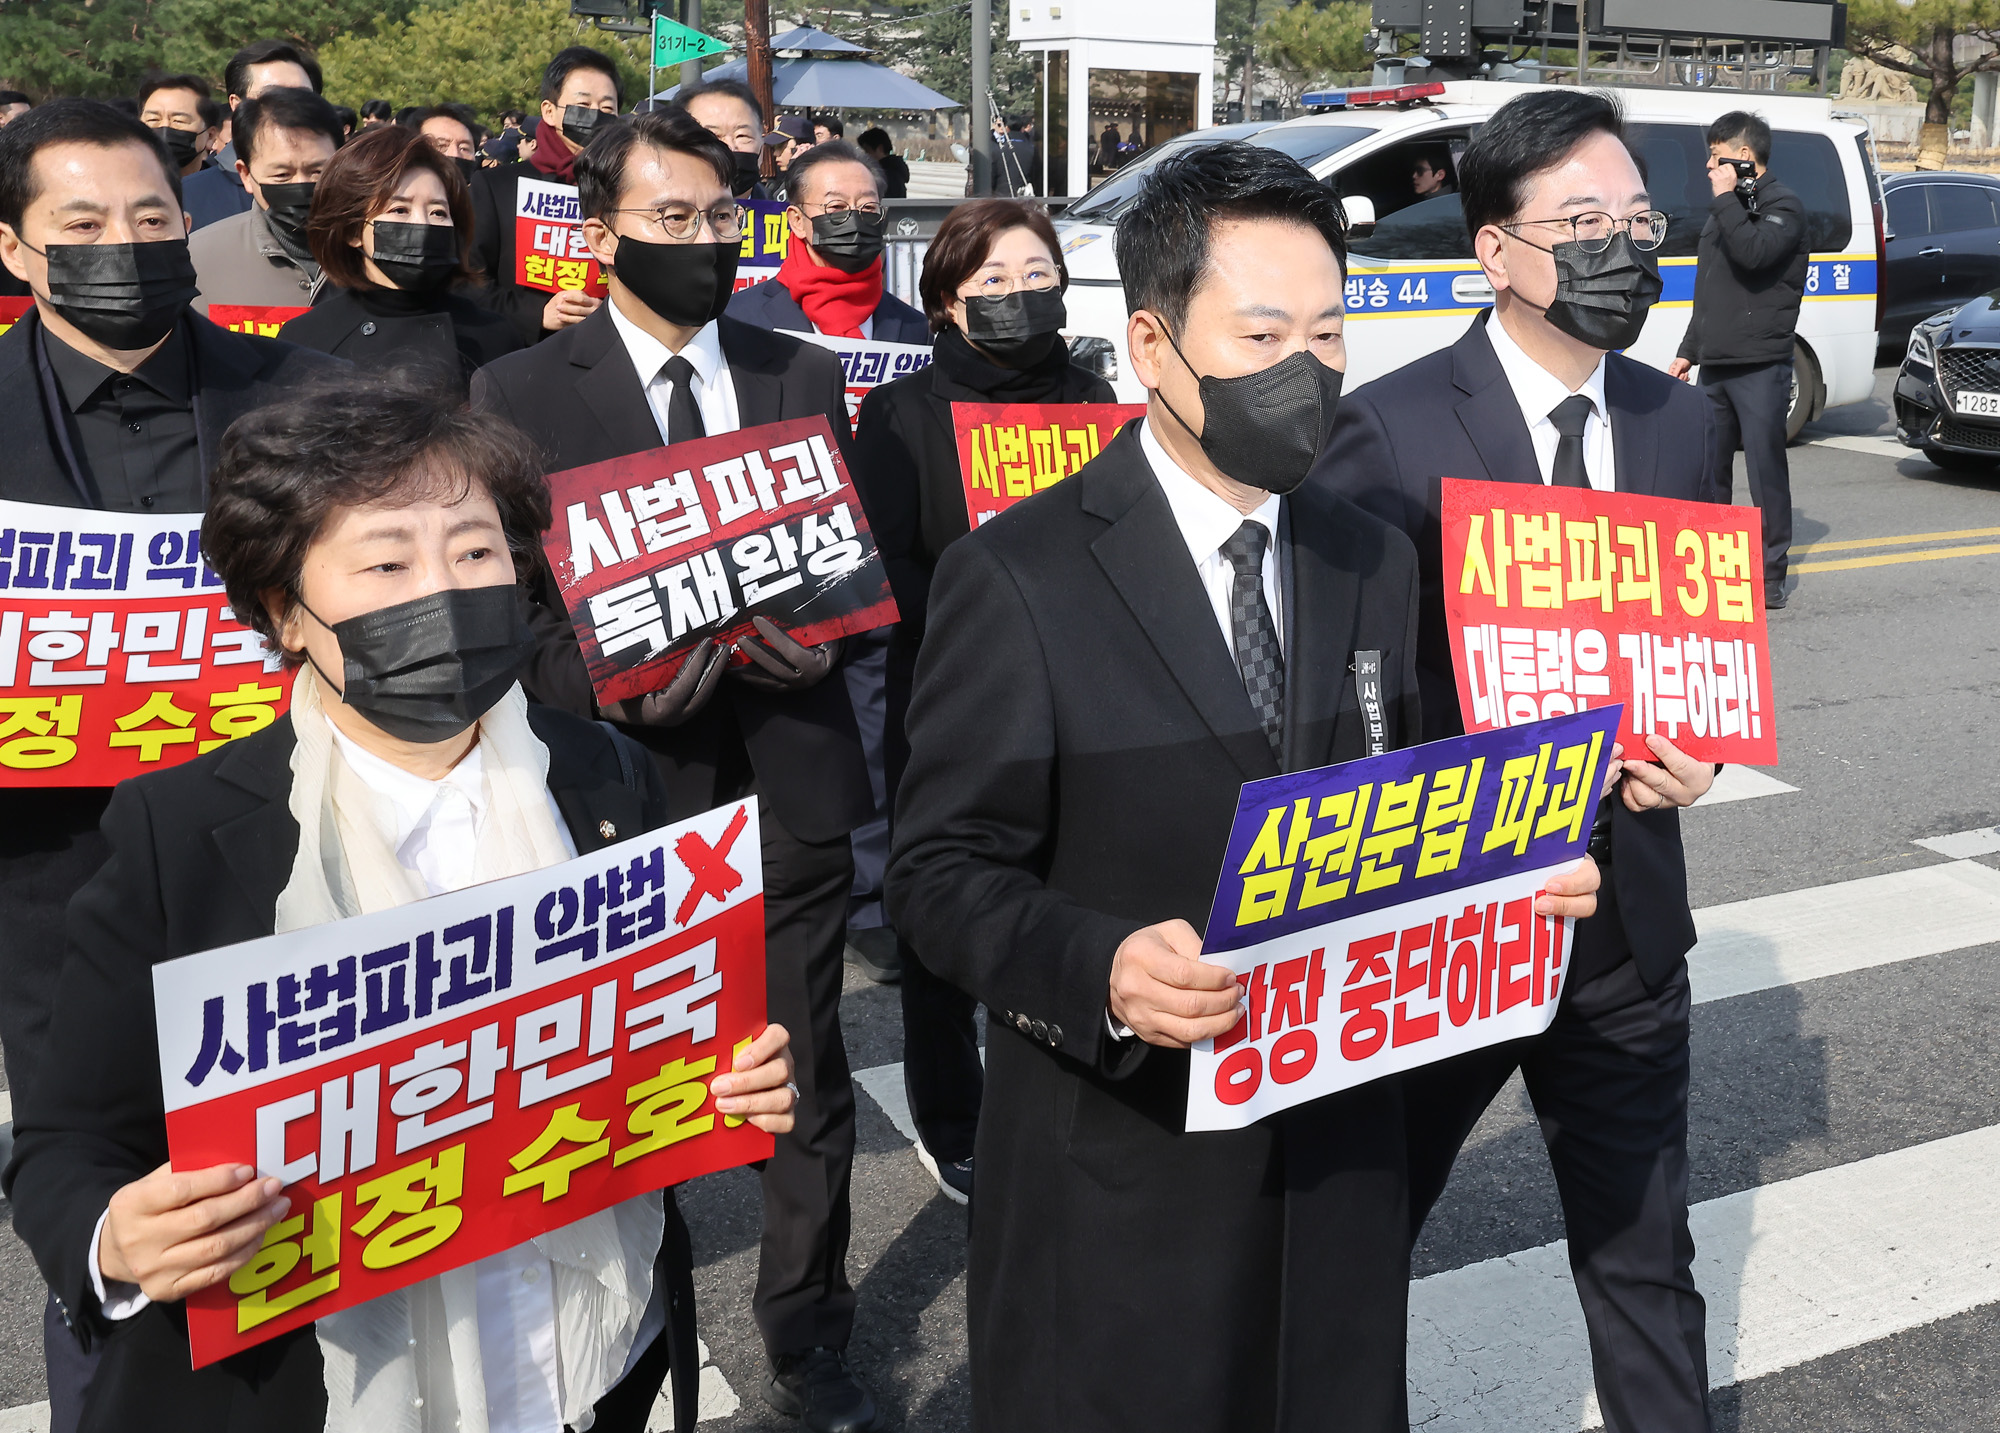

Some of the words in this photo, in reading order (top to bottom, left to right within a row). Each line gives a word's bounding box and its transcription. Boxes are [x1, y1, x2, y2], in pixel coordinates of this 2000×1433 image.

[659, 35, 706, 53] 31기-2
[1344, 277, 1390, 308] 방송
[1398, 277, 1429, 304] 44
[891, 353, 932, 378] 악
[566, 469, 711, 578] 사법
[702, 434, 845, 527] 파괴
[970, 423, 1100, 498] 사법파괴
[587, 548, 739, 659] 독재
[731, 501, 864, 608] 완성
[1459, 508, 1663, 617] 사법파괴
[1674, 528, 1755, 623] 3법
[109, 682, 283, 762] 수호
[1462, 623, 1611, 728] 대통령은
[1617, 631, 1762, 740] 거부하라!
[1235, 756, 1486, 927] 삼권분립
[1481, 730, 1605, 857] 파괴
[184, 904, 514, 1088] 사법파괴
[534, 846, 667, 967] 악법
[1339, 889, 1565, 1062] 중단하라!
[255, 936, 724, 1187] 대한민국
[227, 1142, 466, 1335] 헌정
